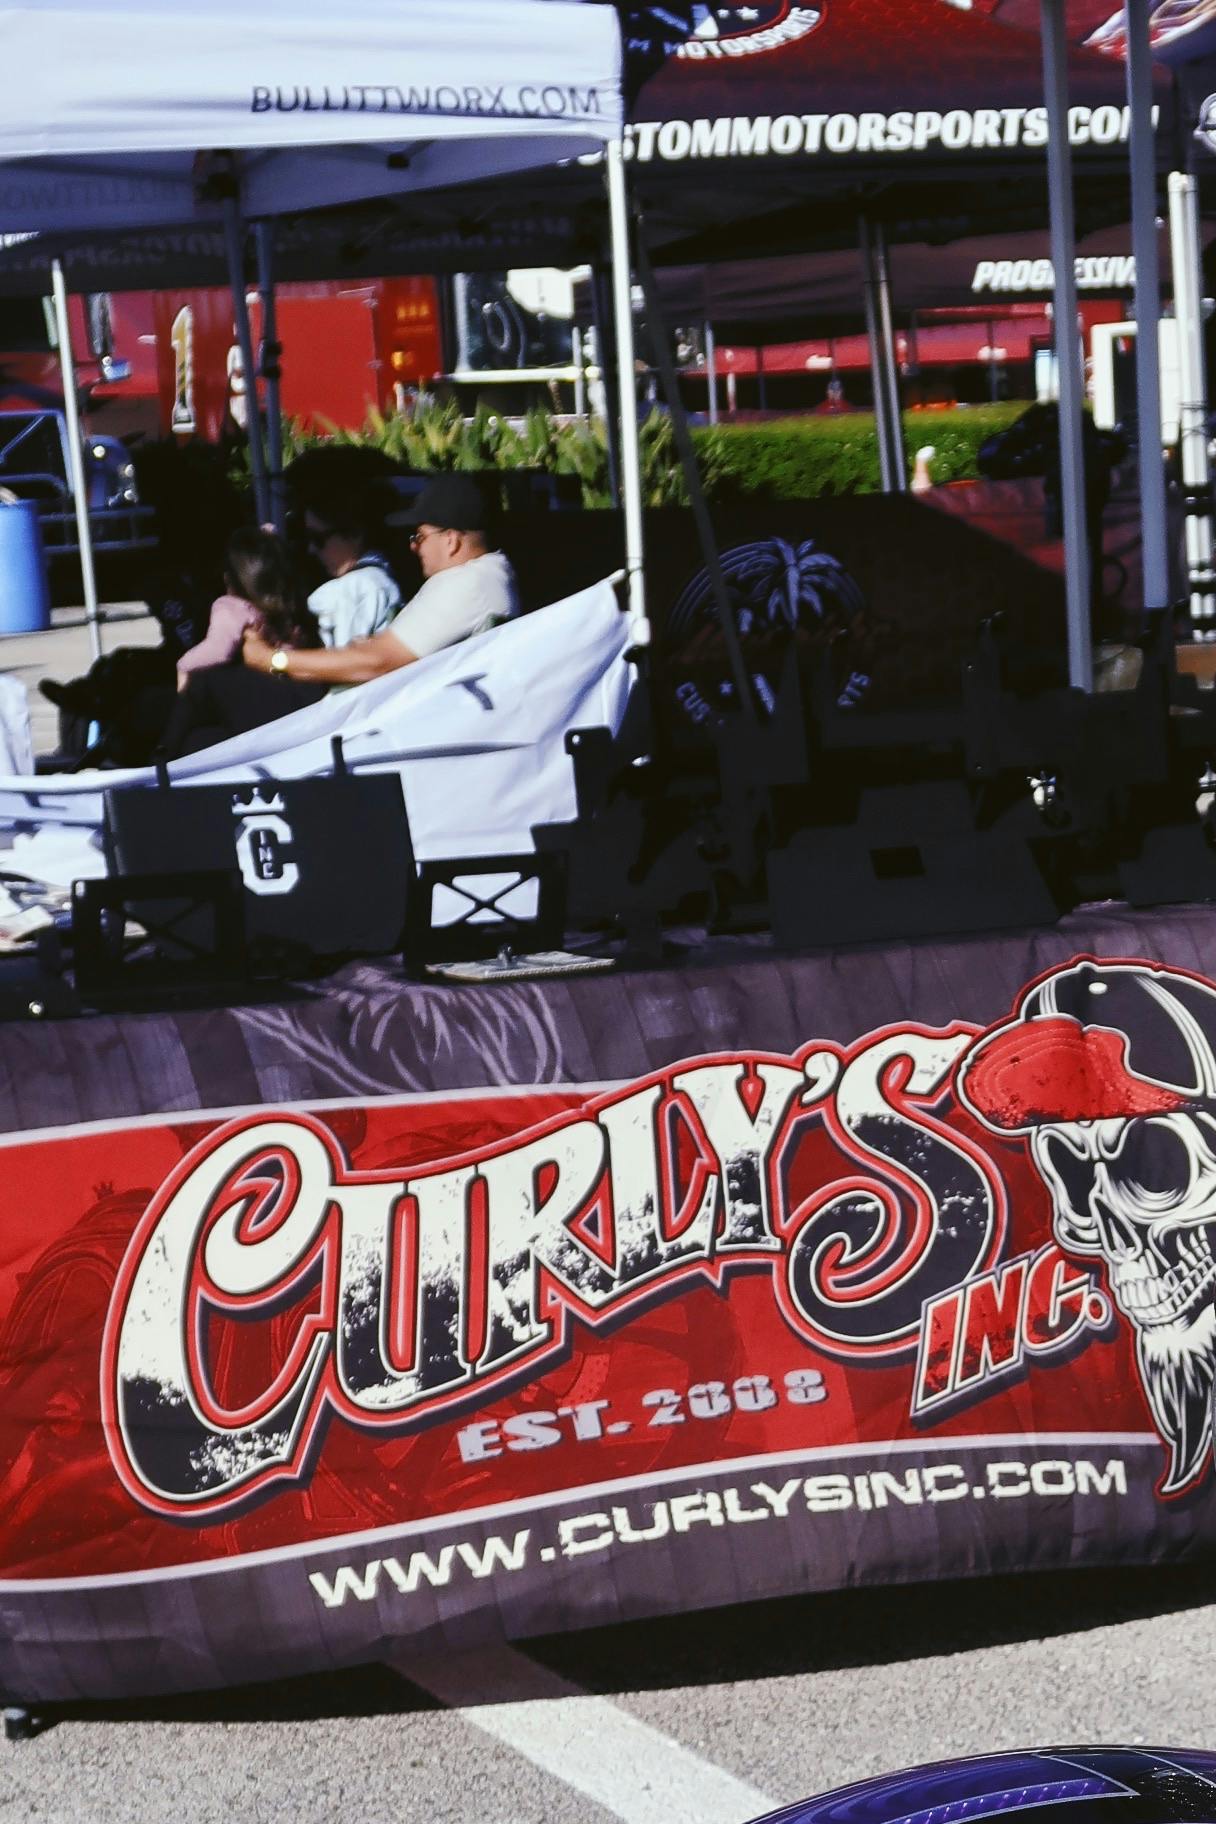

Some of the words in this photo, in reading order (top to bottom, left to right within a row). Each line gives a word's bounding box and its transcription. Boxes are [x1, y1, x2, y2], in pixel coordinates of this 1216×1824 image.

[250, 85, 602, 117] BULLITTWORX.COM
[971, 256, 1138, 292] PROGESSIV
[113, 1031, 988, 1503] CURLY'S
[914, 1245, 1108, 1410] INC.
[456, 1398, 632, 1463] EST.
[309, 1459, 1128, 1608] WWW.CURLYSINC.COM
